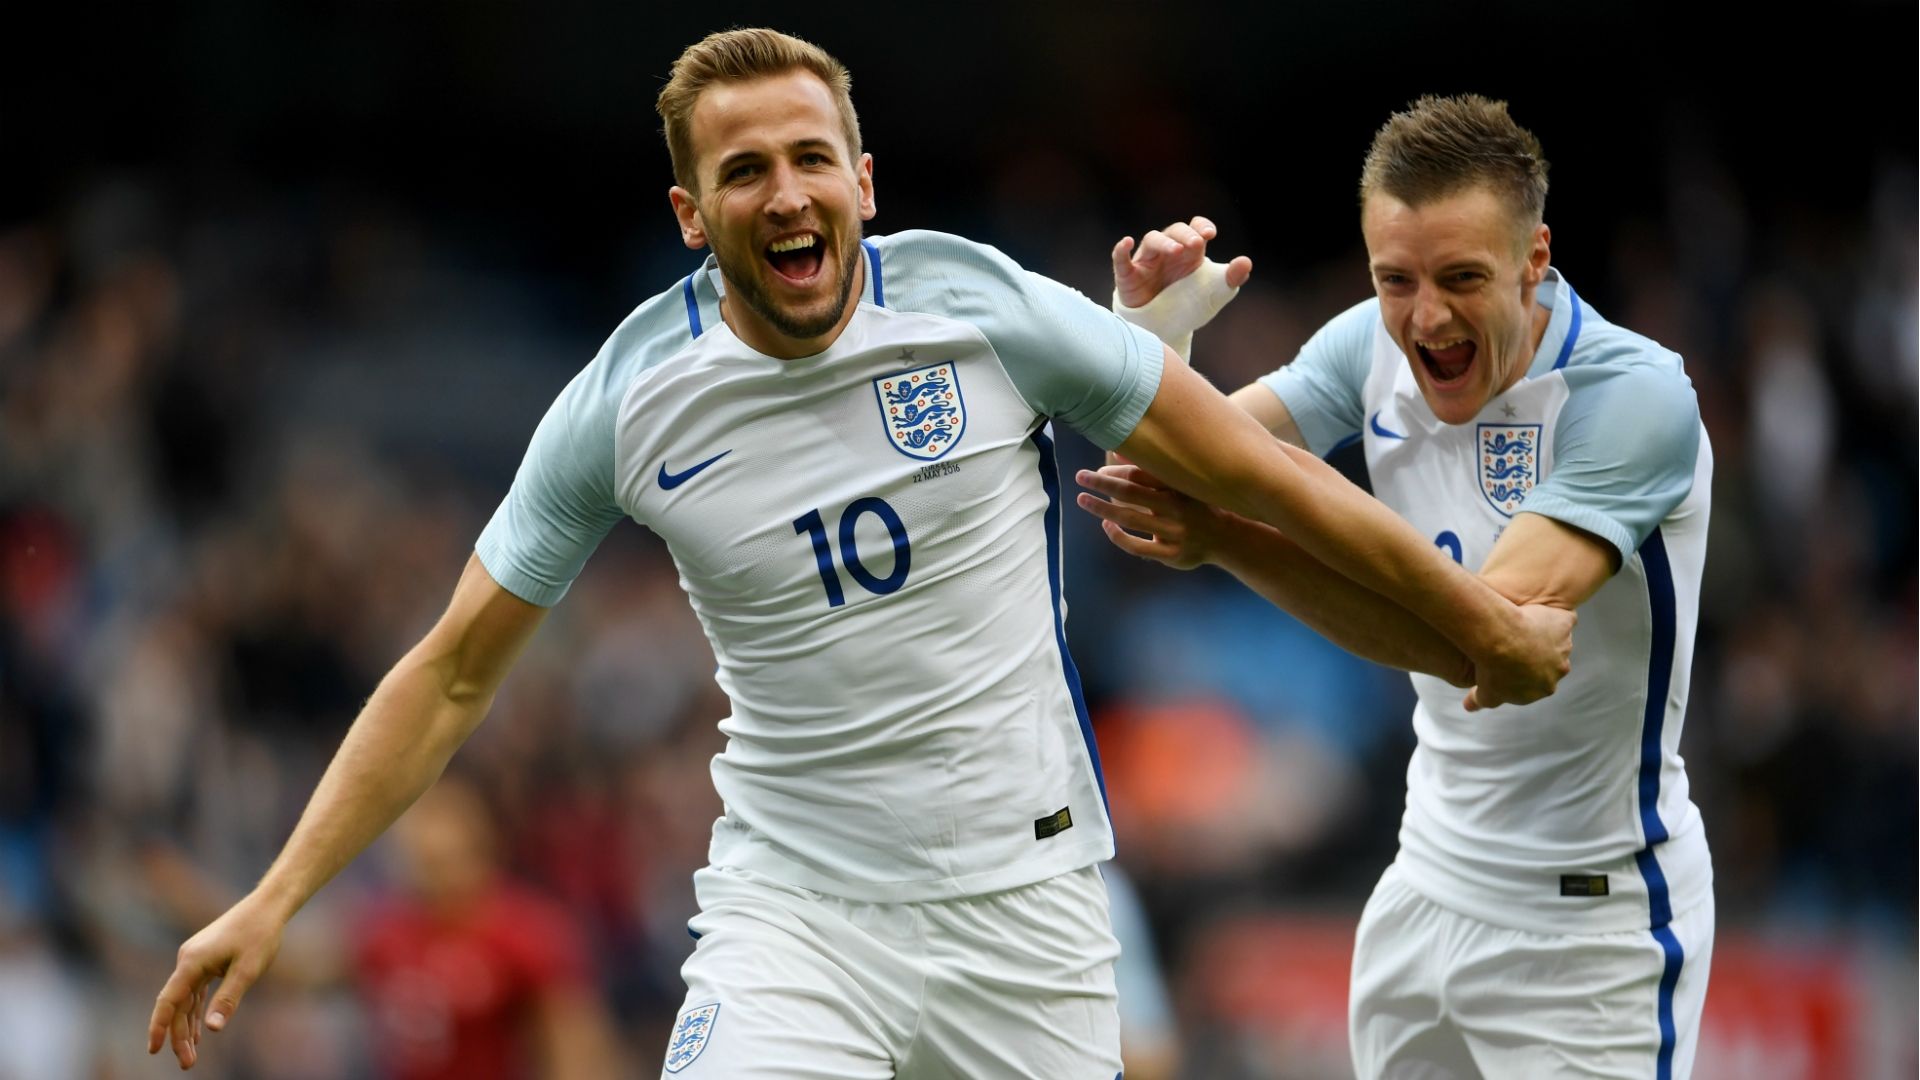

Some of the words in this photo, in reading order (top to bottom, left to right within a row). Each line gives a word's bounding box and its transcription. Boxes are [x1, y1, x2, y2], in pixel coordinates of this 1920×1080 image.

[913, 474, 922, 483] 22
[924, 470, 940, 481] MAY
[943, 463, 961, 476] 2016
[793, 497, 911, 607] 10
